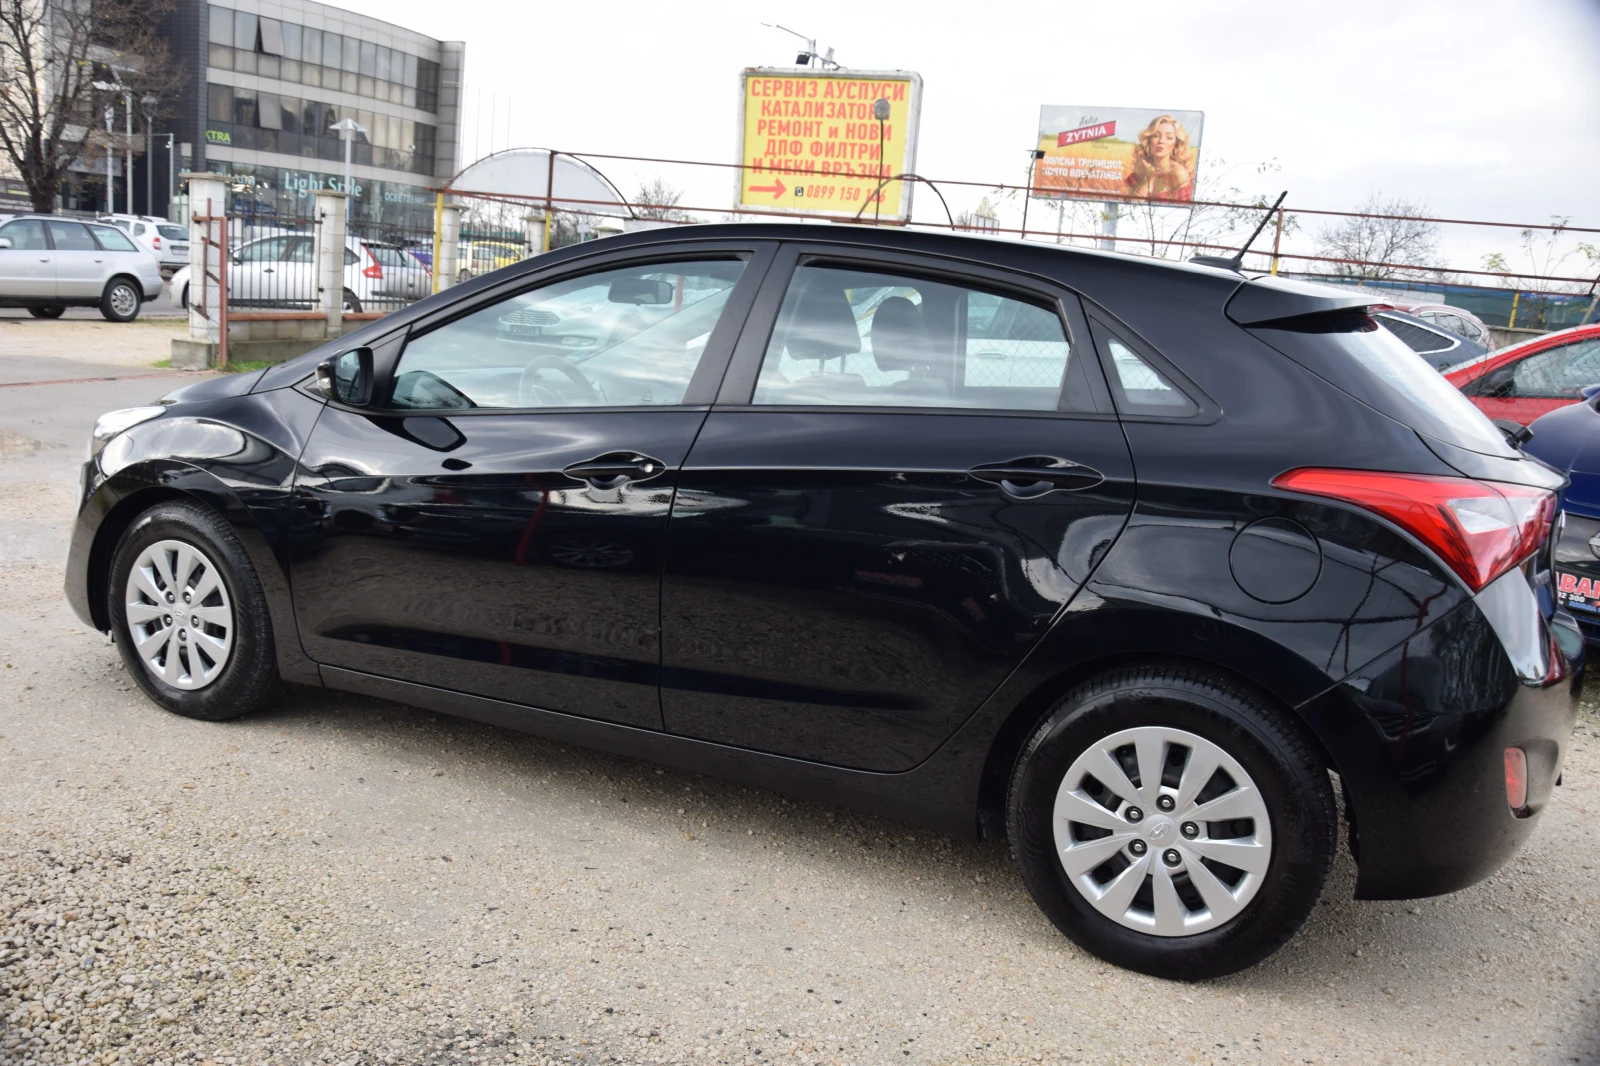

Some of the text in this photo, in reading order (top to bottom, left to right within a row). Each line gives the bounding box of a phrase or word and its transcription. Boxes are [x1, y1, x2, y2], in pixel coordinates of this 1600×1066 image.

[751, 79, 905, 101] СЕРВИЗ АУСПУСИ
[757, 120, 823, 138] РЕМОНТ
[845, 123, 892, 141] НОВИ
[764, 139, 881, 160] ДПФ ФИЛТРИ
[752, 158, 891, 180] И МЕКИ ВРЪЗКИ
[285, 171, 324, 198] Light
[806, 184, 835, 199] 0899
[840, 187, 860, 201] 150
[1568, 594, 1586, 603] 300
